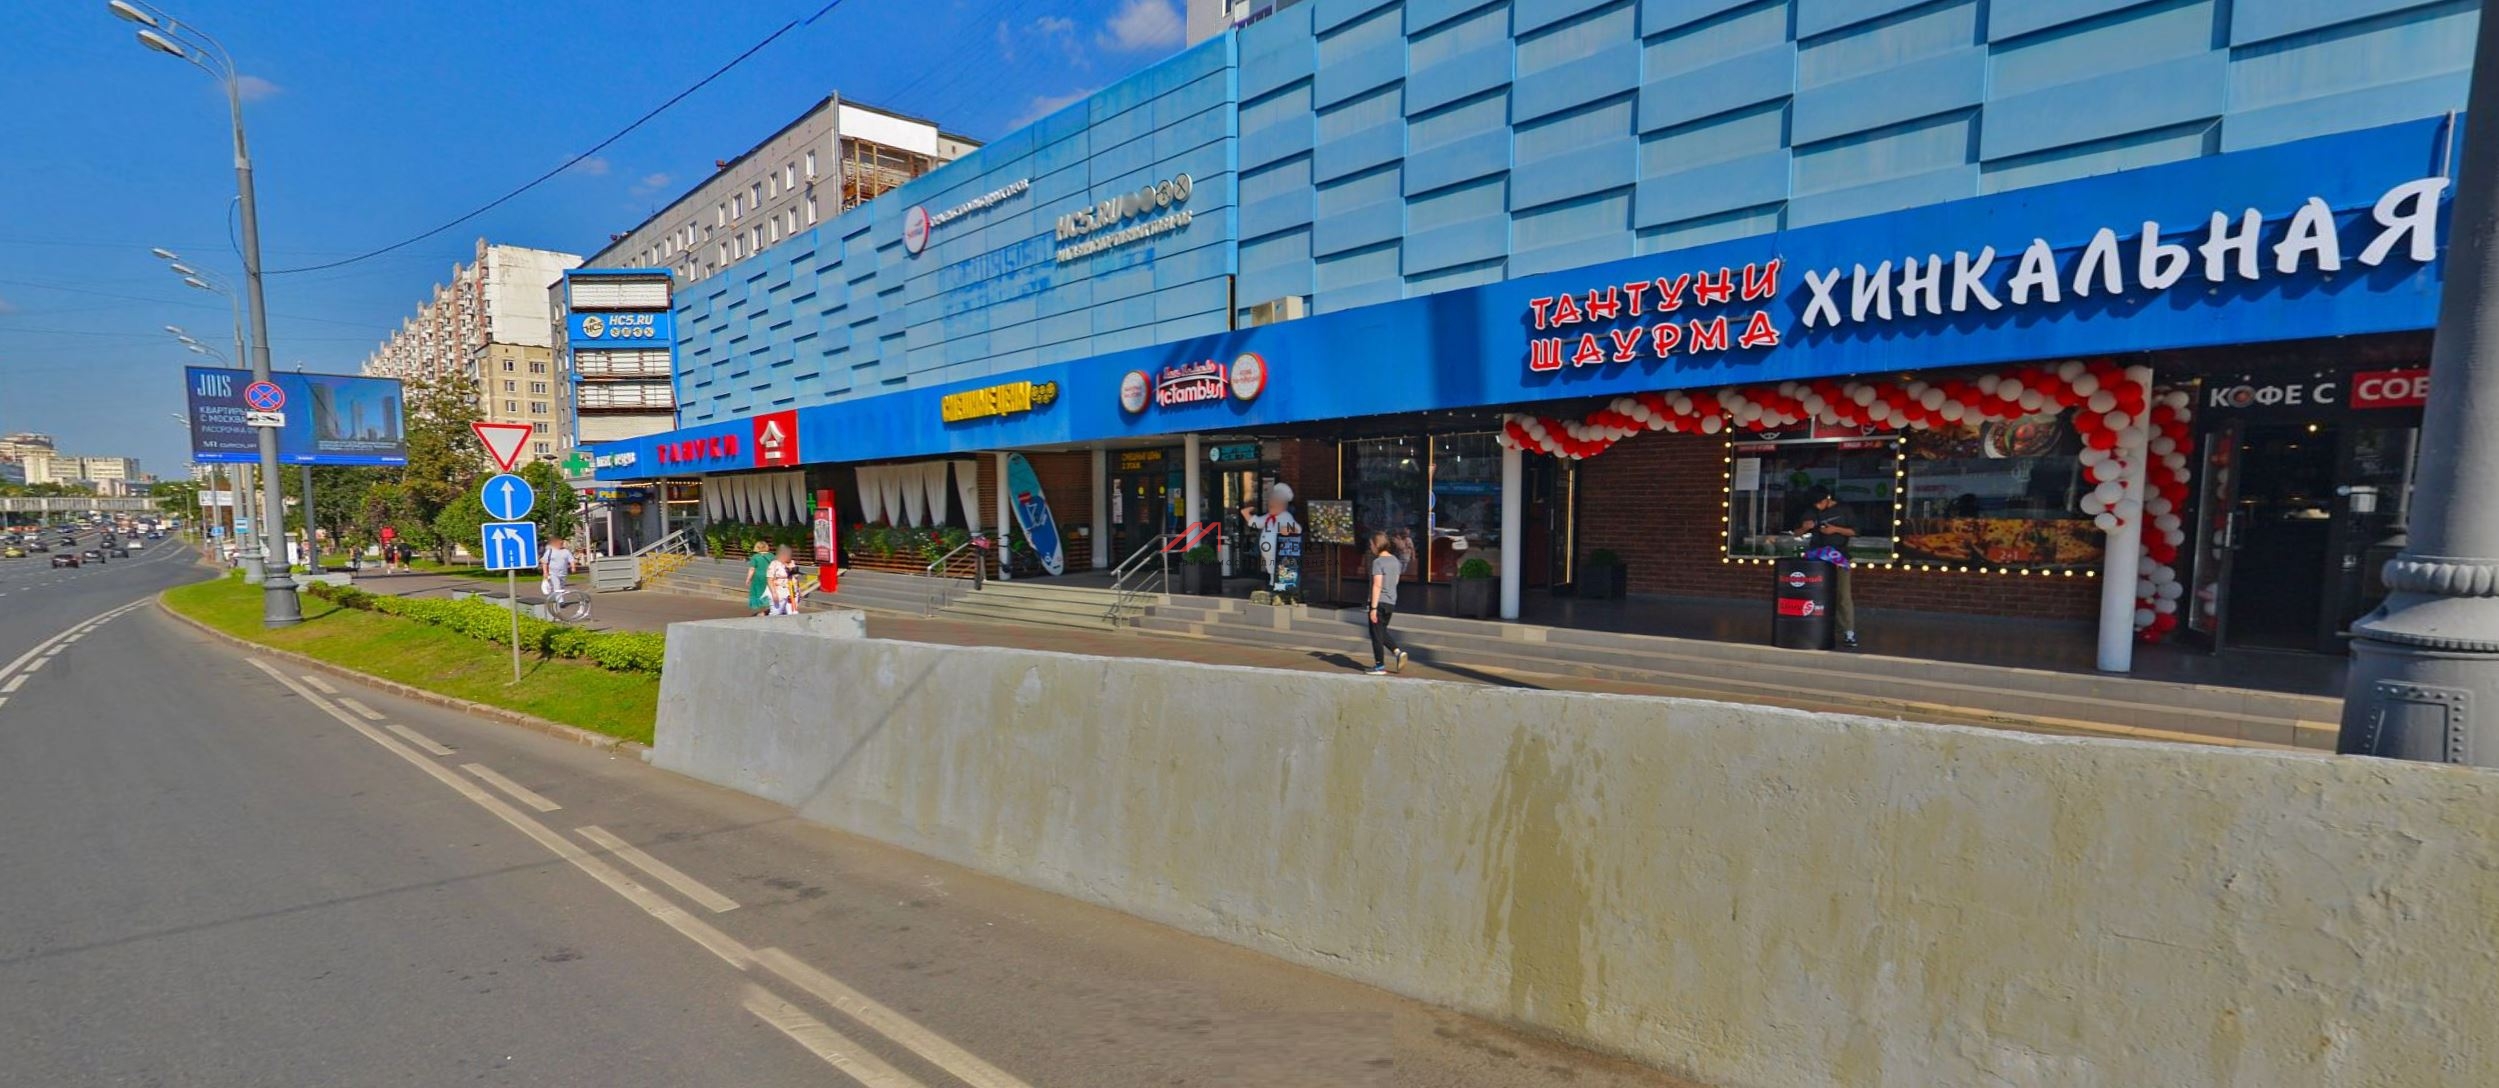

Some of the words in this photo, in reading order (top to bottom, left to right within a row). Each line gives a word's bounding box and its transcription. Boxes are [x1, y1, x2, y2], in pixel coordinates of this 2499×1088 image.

[1802, 177, 2450, 328] ХИНКАЛЬНАЯ
[609, 314, 654, 325] HC5.RU
[1529, 258, 1781, 330] ТАНТУНИ
[1529, 309, 1781, 372] ШАУРМА
[197, 374, 232, 397] JOIS
